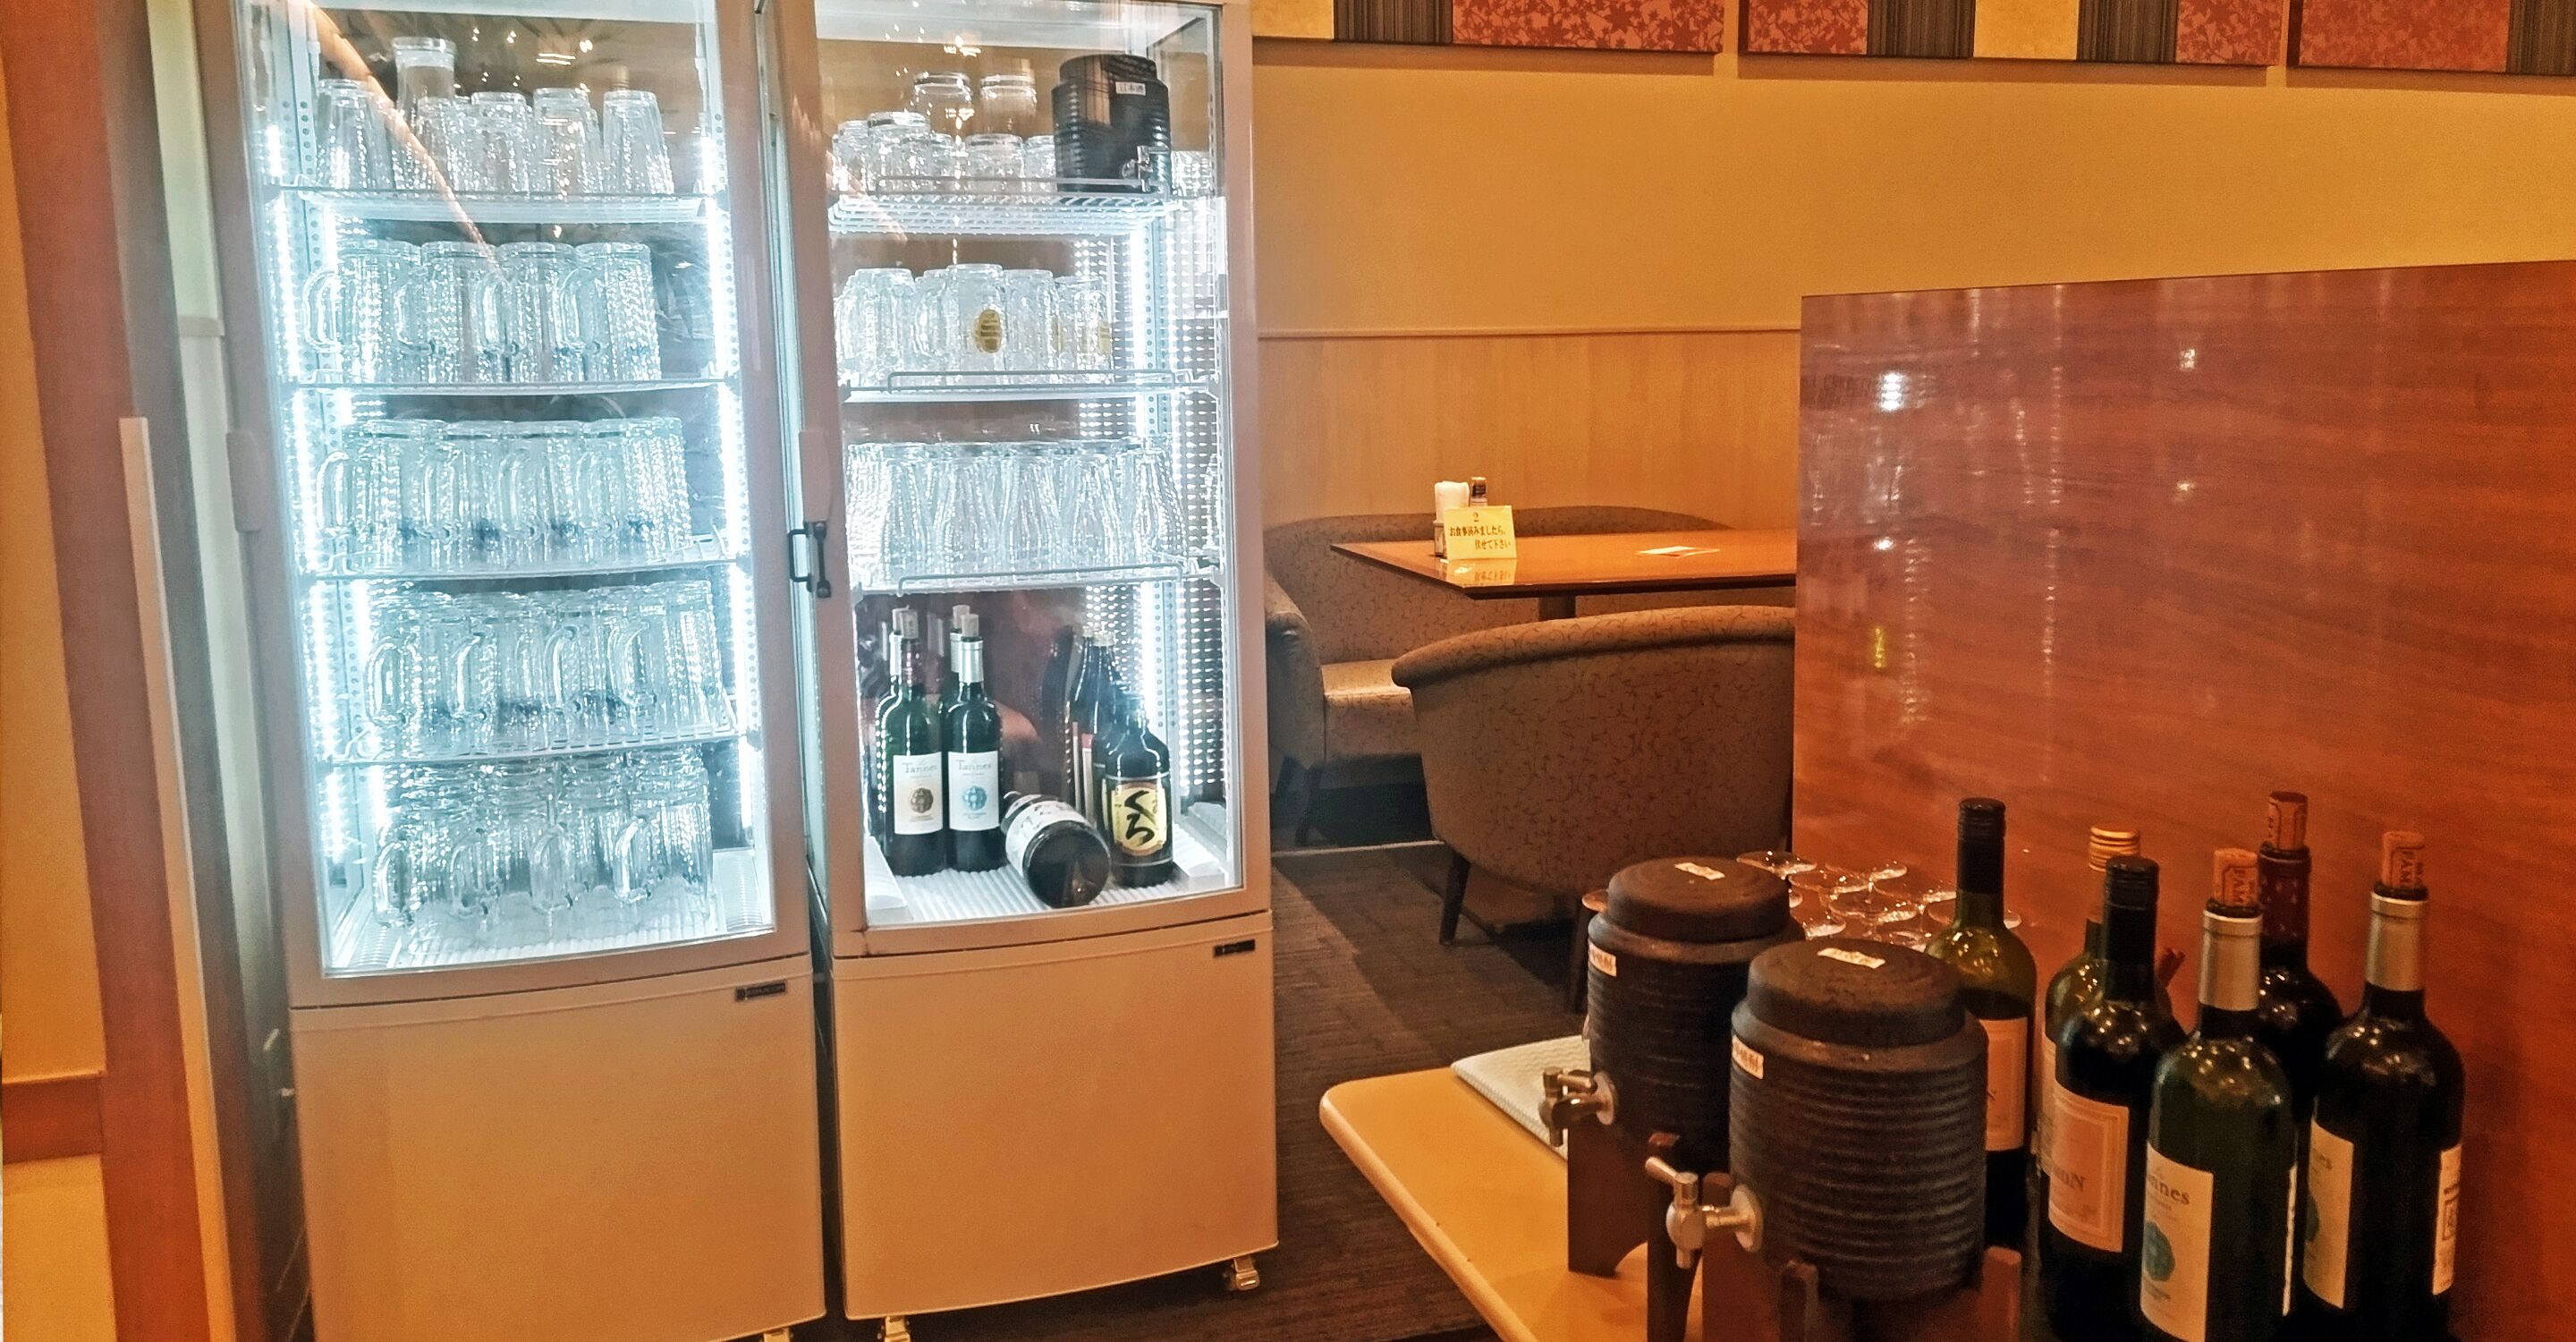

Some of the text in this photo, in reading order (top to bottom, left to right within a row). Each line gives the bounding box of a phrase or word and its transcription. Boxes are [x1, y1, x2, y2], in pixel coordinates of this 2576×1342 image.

[1473, 512, 1479, 522] 2
[1474, 538, 1511, 550] 伏せて下さい
[1123, 789, 1156, 847] くろ
